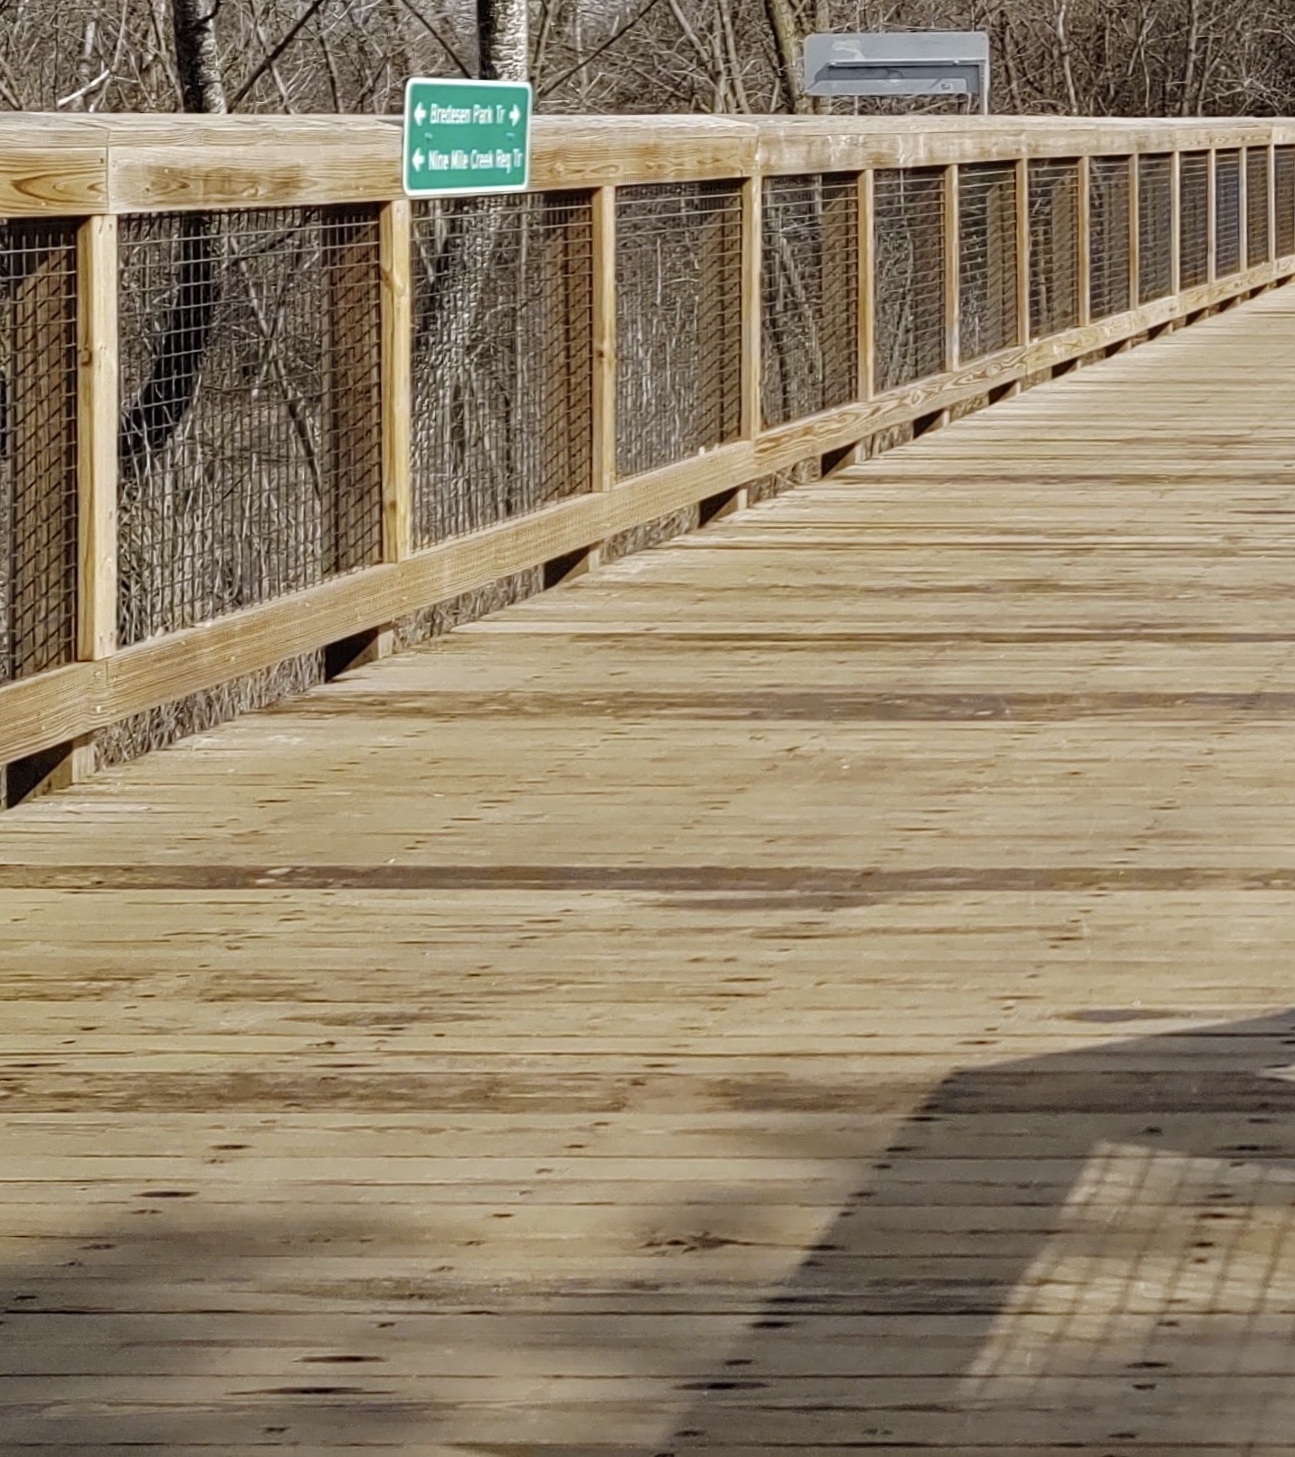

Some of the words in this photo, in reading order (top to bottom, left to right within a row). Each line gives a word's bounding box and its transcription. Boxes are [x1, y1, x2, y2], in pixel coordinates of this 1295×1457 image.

[430, 103, 471, 124] Bredesen
[472, 104, 493, 124] Park
[496, 104, 506, 124] Tr
[428, 150, 449, 170] Nine
[450, 150, 469, 169] Mile
[471, 150, 493, 169] Creek
[496, 150, 511, 174] Reg
[513, 148, 523, 168] Tr
